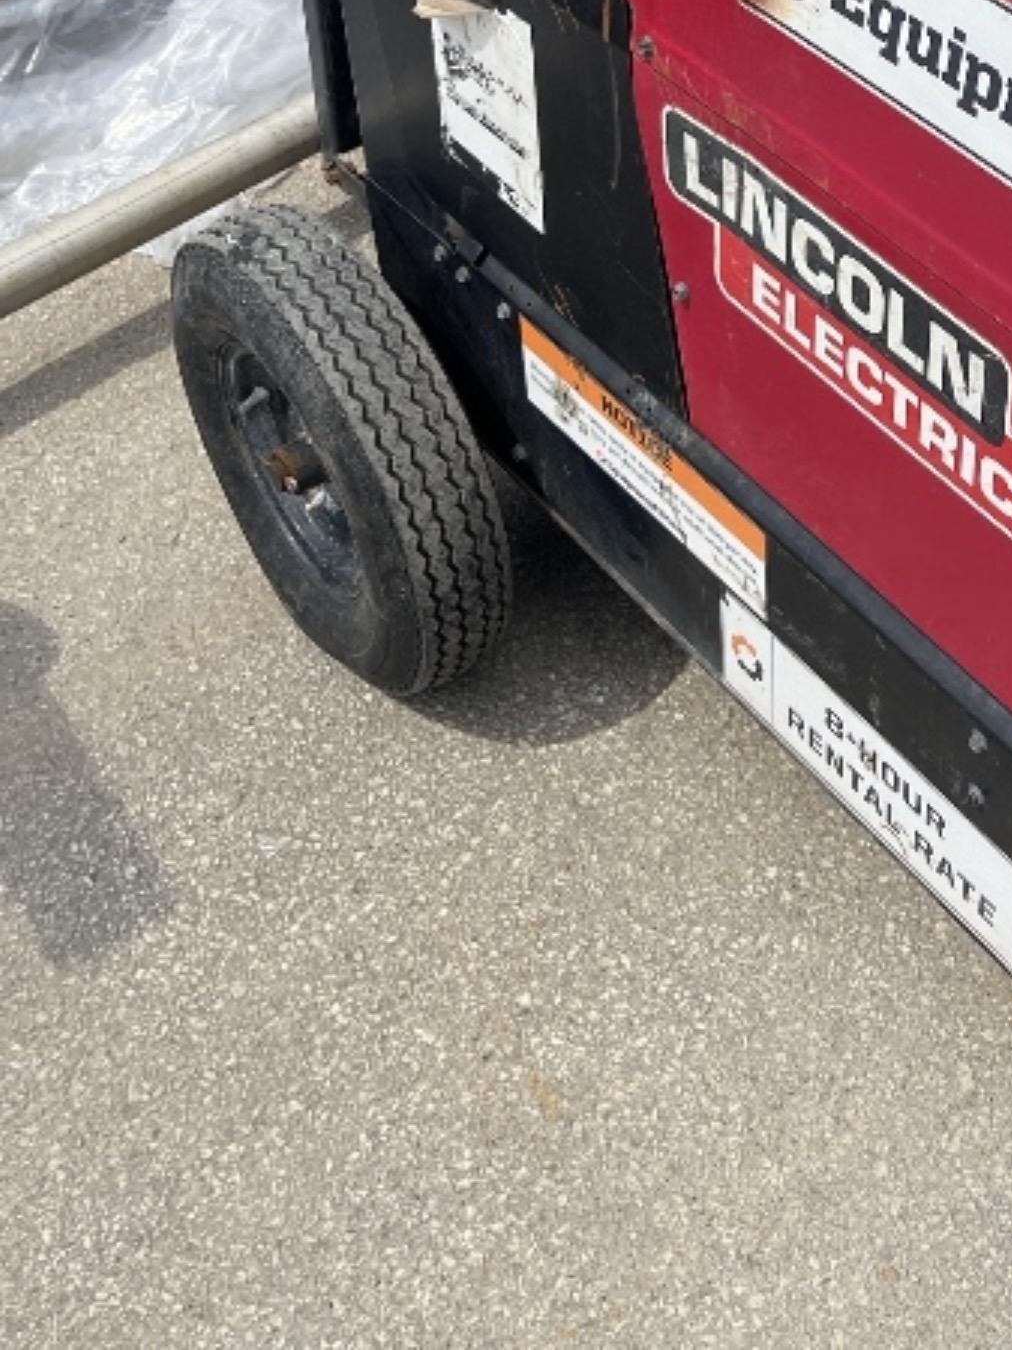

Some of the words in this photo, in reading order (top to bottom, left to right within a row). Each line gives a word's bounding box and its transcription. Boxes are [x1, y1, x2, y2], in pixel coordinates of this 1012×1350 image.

[683, 131, 987, 421] LINCOLN
[788, 707, 902, 836] RENTAL
[914, 830, 998, 928] RATE
[825, 707, 947, 838] 8-HOUR
